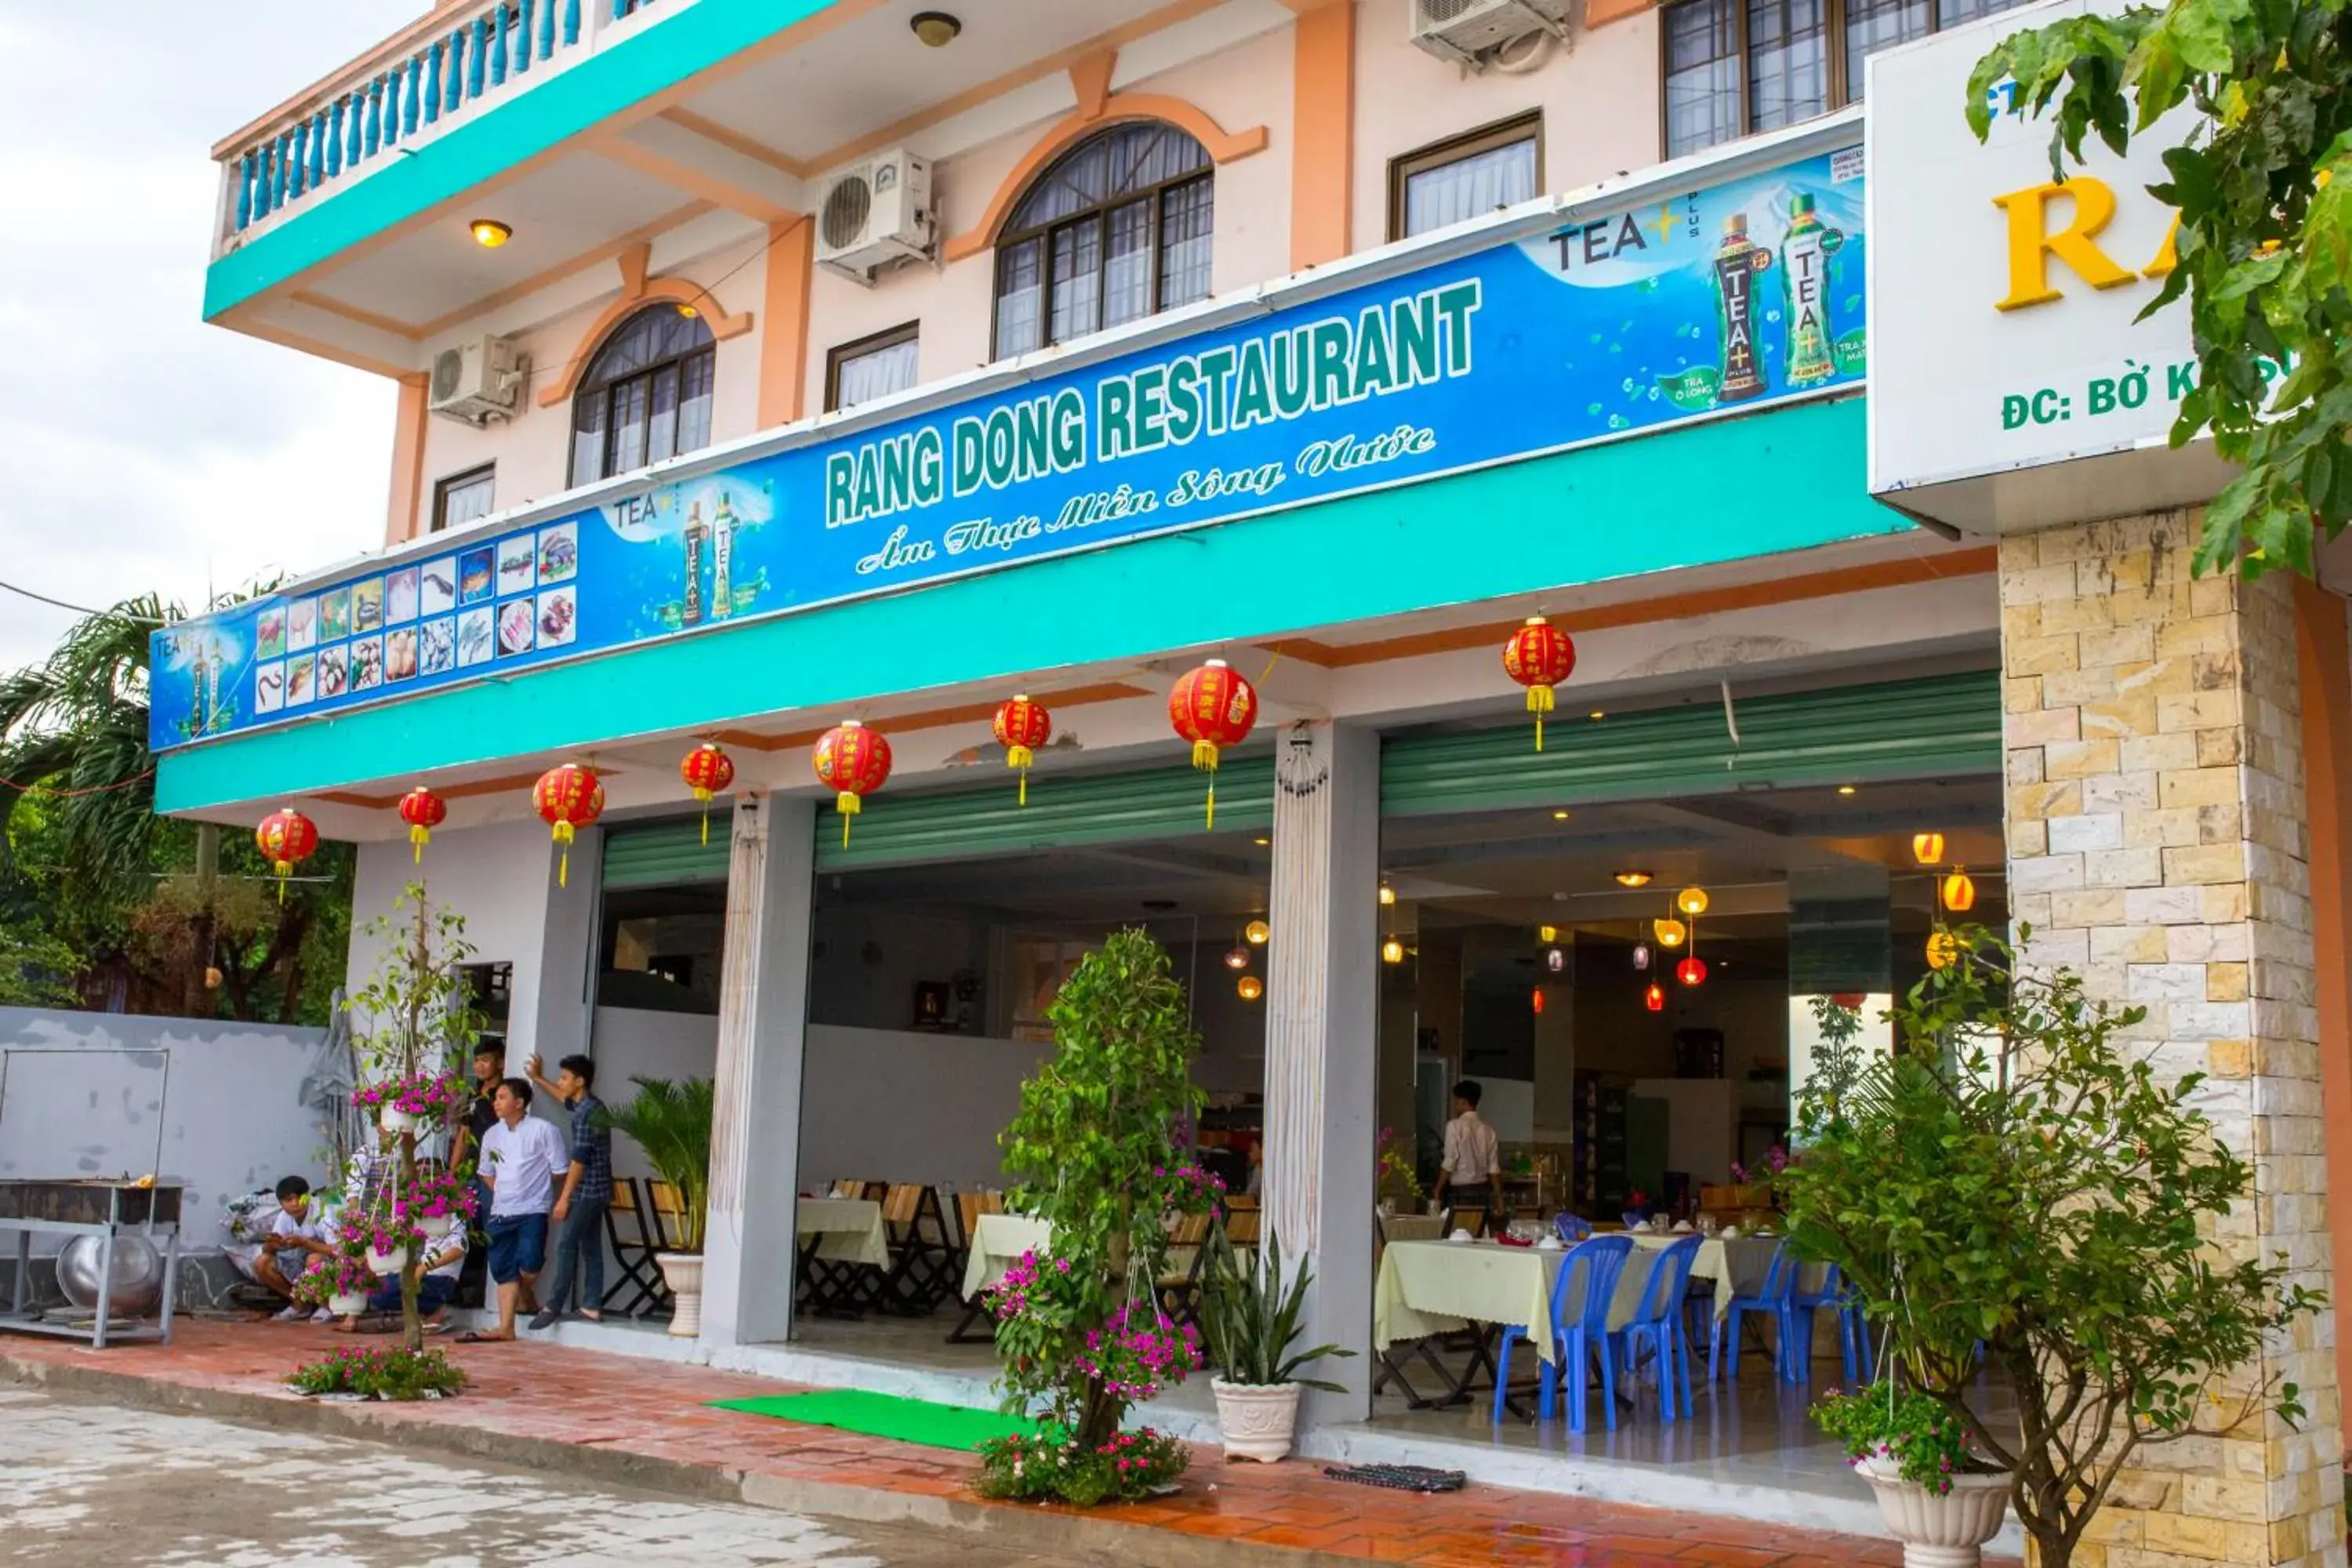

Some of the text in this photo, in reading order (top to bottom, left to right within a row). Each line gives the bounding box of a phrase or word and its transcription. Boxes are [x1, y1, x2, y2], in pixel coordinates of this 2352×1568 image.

[826, 278, 1483, 528] RANG DONG RESTAURANT
[2001, 388, 2071, 430] ĐC:
[2088, 358, 2151, 416] BỜ
[944, 514, 1041, 556] Thực
[1046, 483, 1160, 533] Miền
[1165, 461, 1287, 507] Sông
[1296, 424, 1436, 477] Nước
